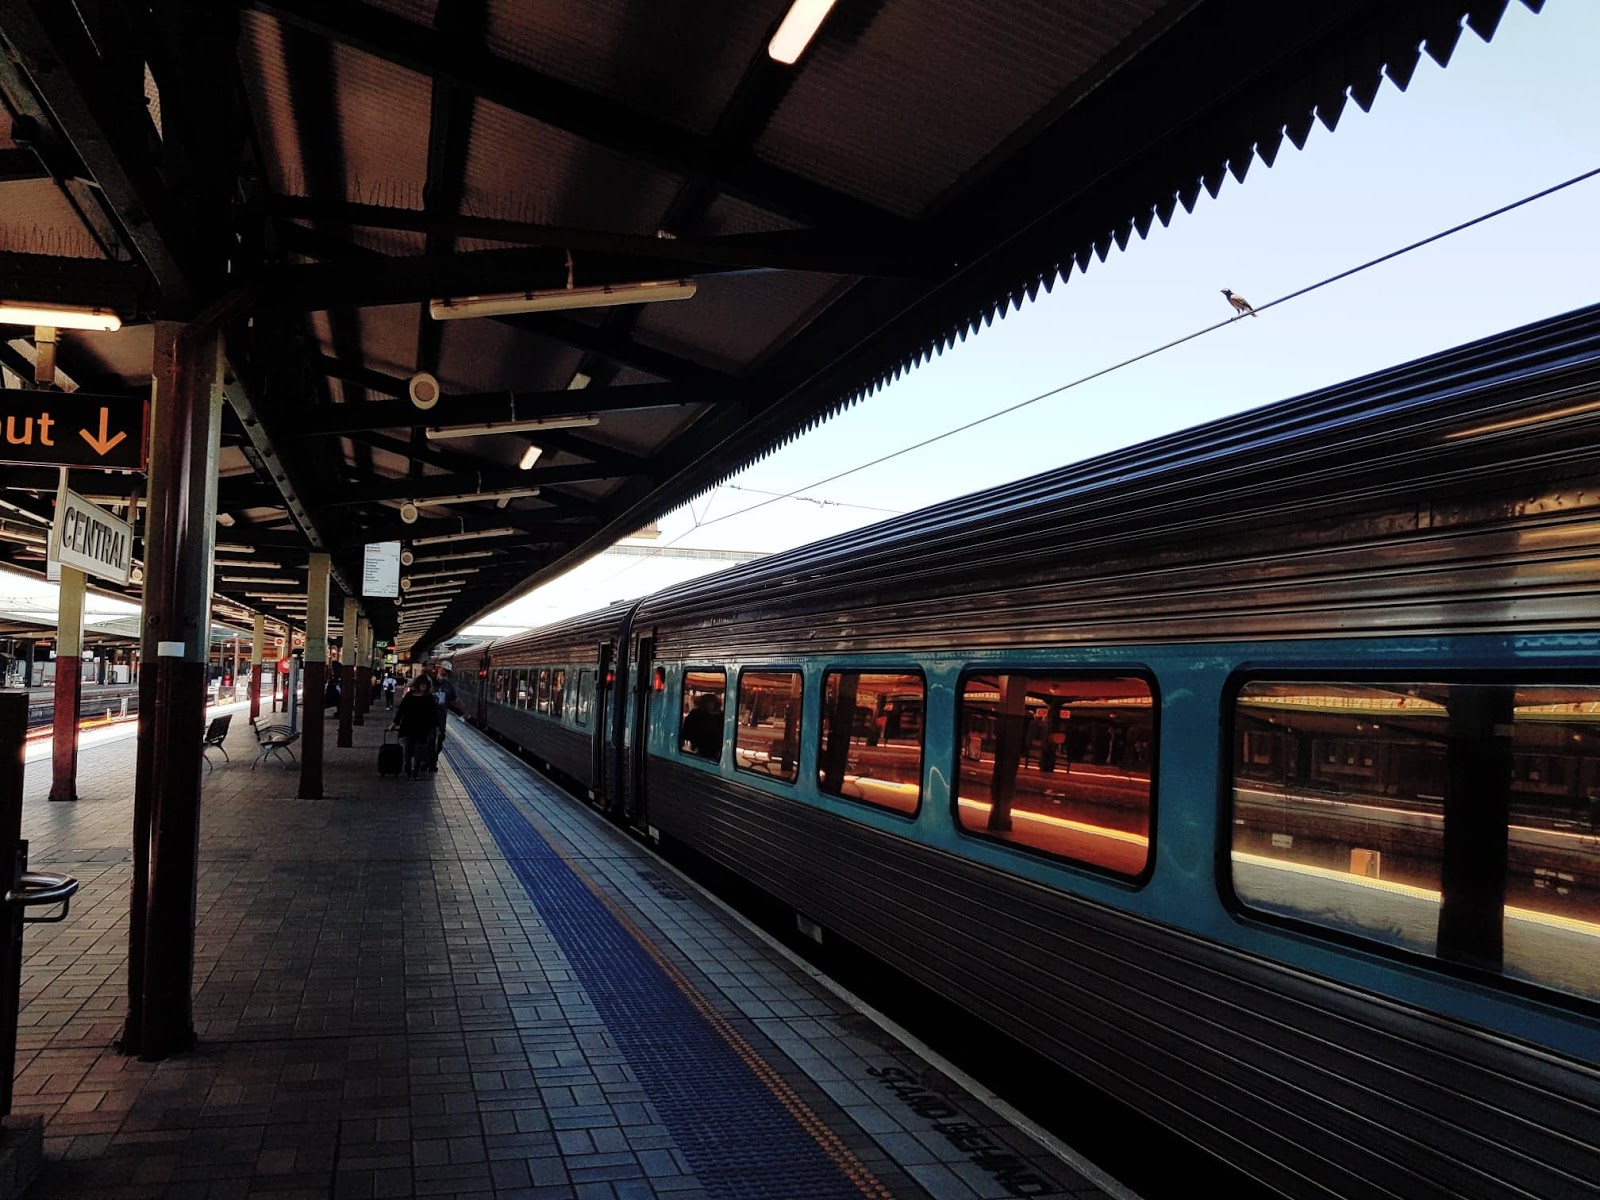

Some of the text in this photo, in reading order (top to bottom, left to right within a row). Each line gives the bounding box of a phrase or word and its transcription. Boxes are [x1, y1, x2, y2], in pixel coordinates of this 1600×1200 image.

[0, 412, 55, 447] ut
[62, 506, 128, 571] CENTRAL
[866, 1067, 958, 1119] STAND
